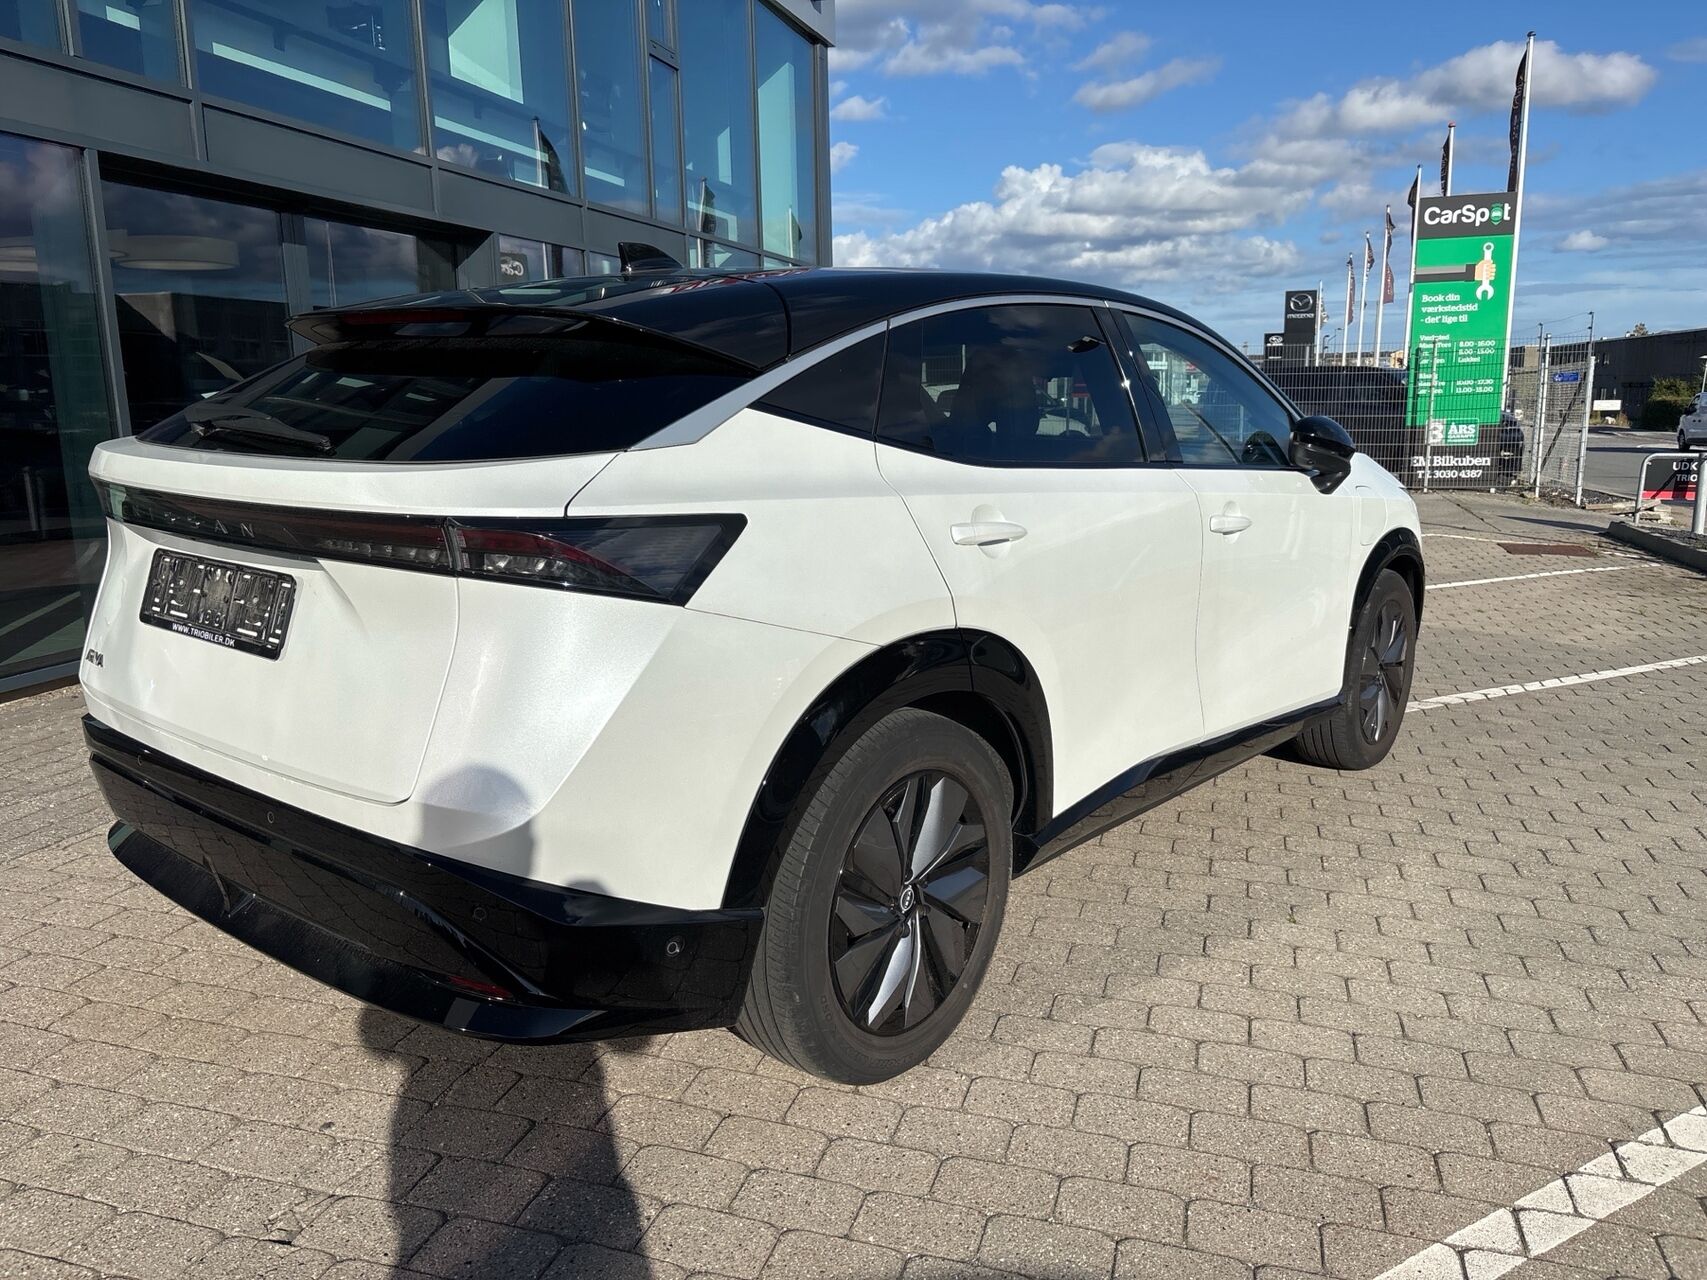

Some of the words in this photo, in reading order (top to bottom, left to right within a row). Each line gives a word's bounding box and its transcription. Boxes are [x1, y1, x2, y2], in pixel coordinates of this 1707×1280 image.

[1422, 294, 1445, 303] Book
[1445, 293, 1460, 301] din
[1442, 315, 1458, 325] lige
[1458, 314, 1468, 323] til
[1448, 422, 1476, 434] ÅRS
[1433, 455, 1491, 467] Bilkuben
[1672, 461, 1698, 471] UDK
[1433, 470, 1458, 478] 3030
[1459, 469, 1482, 478] 4387
[172, 623, 235, 647] WWW.TRIOBILER.DK
